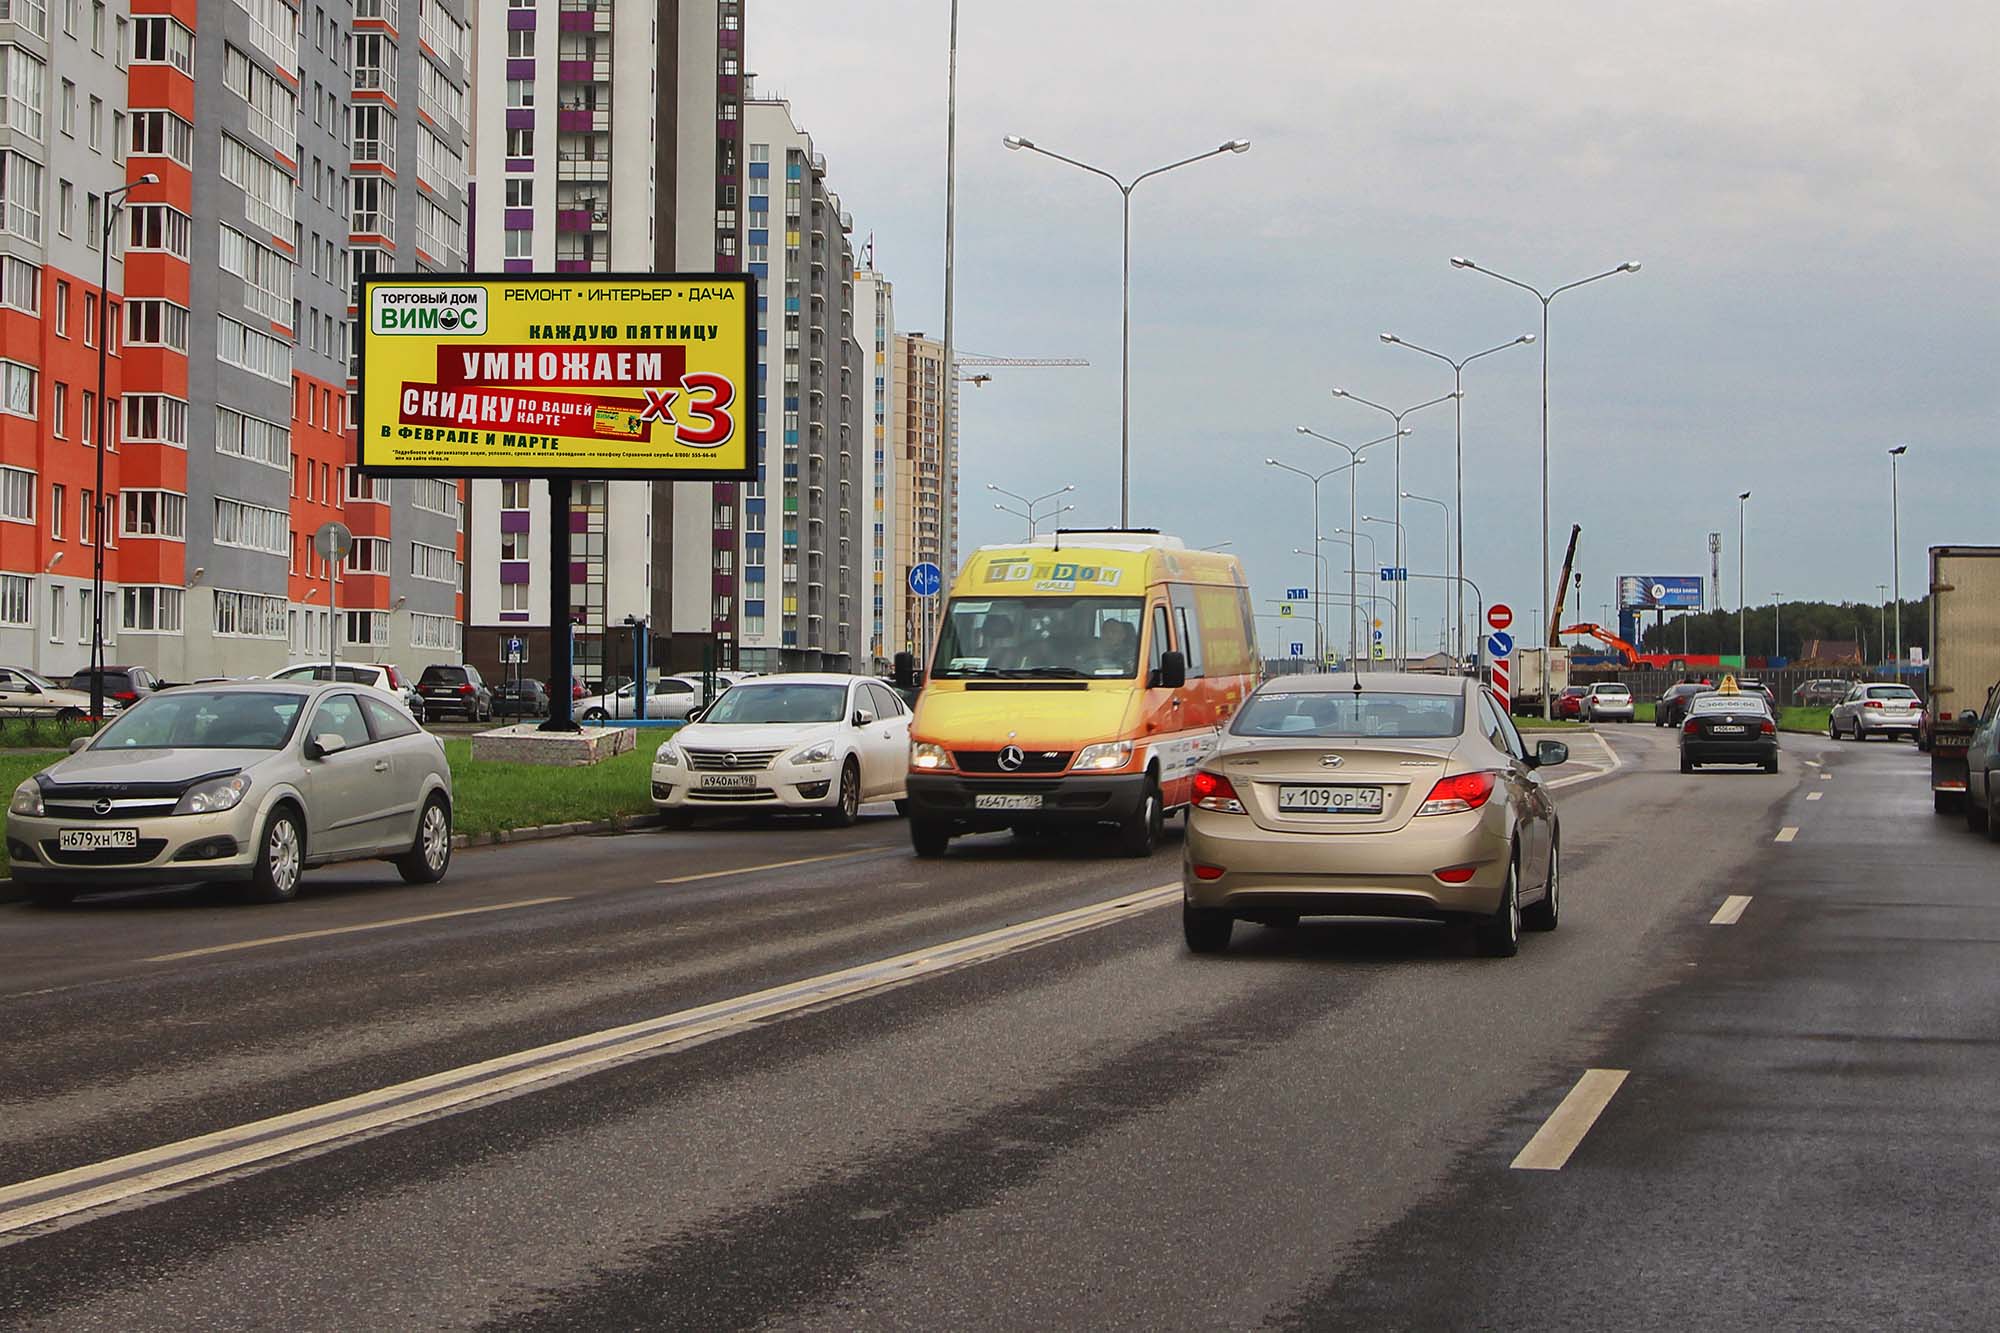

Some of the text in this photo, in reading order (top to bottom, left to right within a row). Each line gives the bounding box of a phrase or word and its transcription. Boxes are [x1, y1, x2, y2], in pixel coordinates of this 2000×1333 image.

[381, 292, 478, 305] ТОРГОВЫЙ ДОМ
[504, 288, 735, 302] РЕМОНТ ИНТЕРЬЕР ДАЧА
[381, 307, 478, 330] ВИМОС
[529, 325, 718, 341] КАЖДУЮ ПЯТНИЦУ
[462, 352, 662, 381] УМНОЖАЕМ
[402, 388, 514, 424] СКИДКУ
[517, 399, 537, 412] ПО
[542, 402, 592, 416] ВАШЕЙ
[381, 425, 559, 450] В ФЕВРАЛЕ И МАРТЕ
